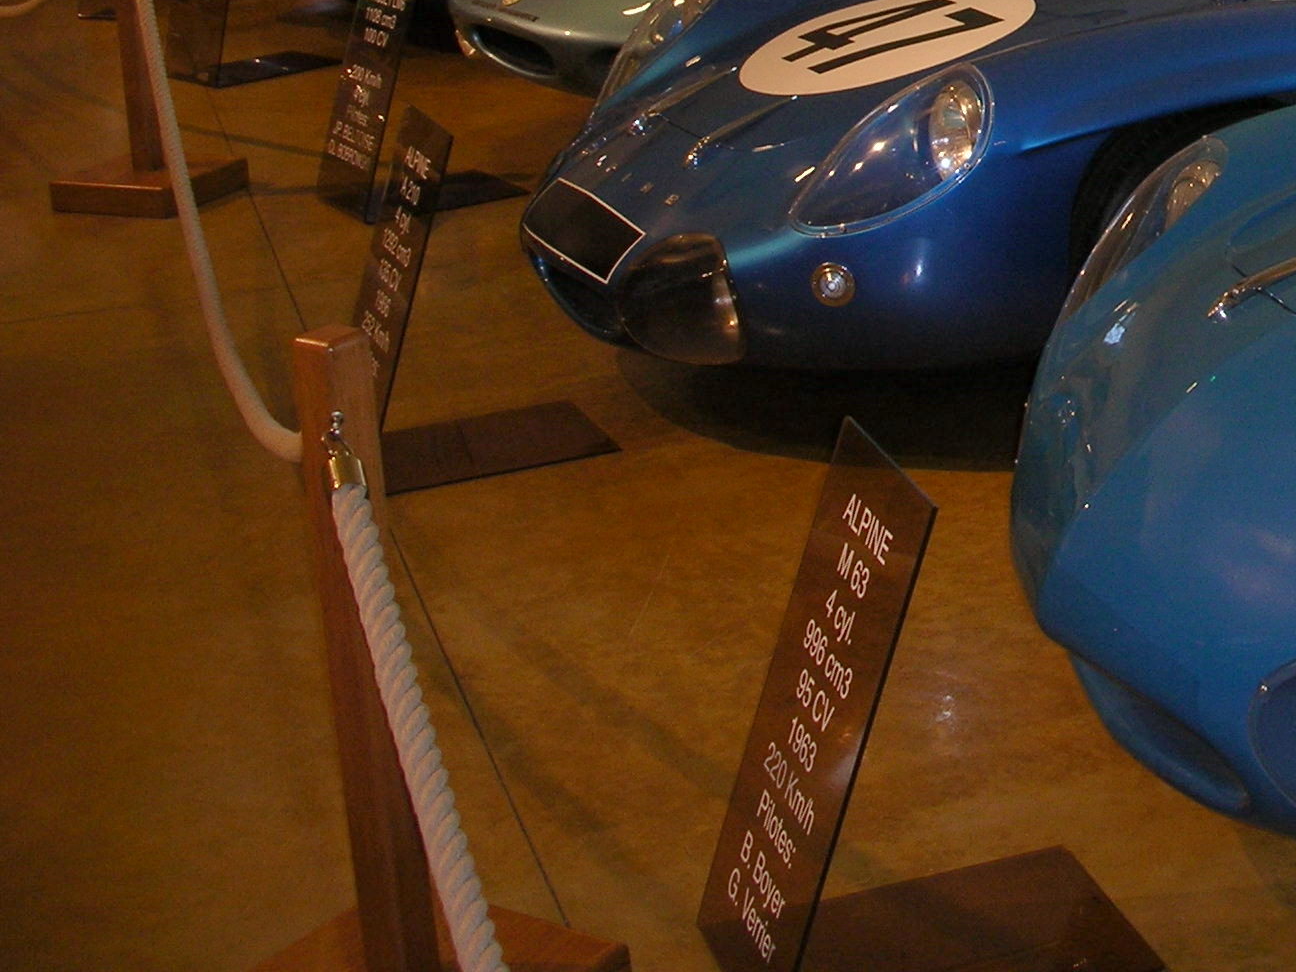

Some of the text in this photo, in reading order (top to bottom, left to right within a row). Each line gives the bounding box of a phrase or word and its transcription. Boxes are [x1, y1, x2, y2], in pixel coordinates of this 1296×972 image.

[404, 146, 432, 179] ALPINE
[842, 493, 893, 566] ALPINE
[836, 542, 870, 599] M 63
[825, 589, 856, 646] 4 cyl.
[803, 618, 853, 700] 996 cm3
[796, 668, 835, 732] 95 CV
[787, 716, 818, 772] 1963
[763, 741, 815, 836] 220 Km/h
[756, 789, 796, 869] Pilotes:
[740, 829, 786, 920] B. Boyer
[727, 867, 777, 964] G. Verrier
